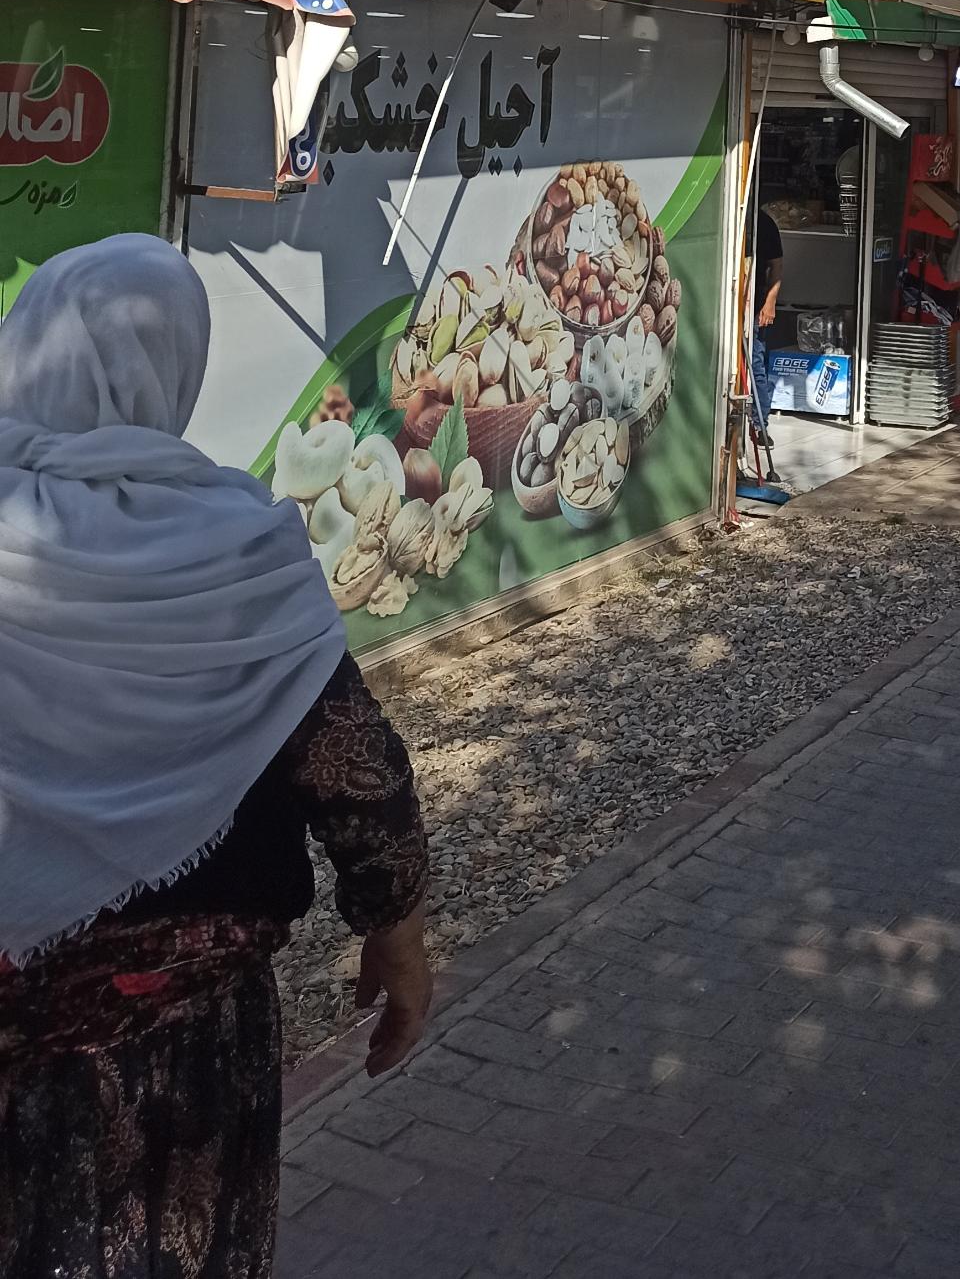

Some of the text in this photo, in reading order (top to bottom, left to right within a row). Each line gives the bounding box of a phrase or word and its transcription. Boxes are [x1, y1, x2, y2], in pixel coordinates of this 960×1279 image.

[319, 44, 561, 187] آجیل خشکبا
[773, 357, 810, 369] EDGE
[815, 369, 832, 407] EDGE
